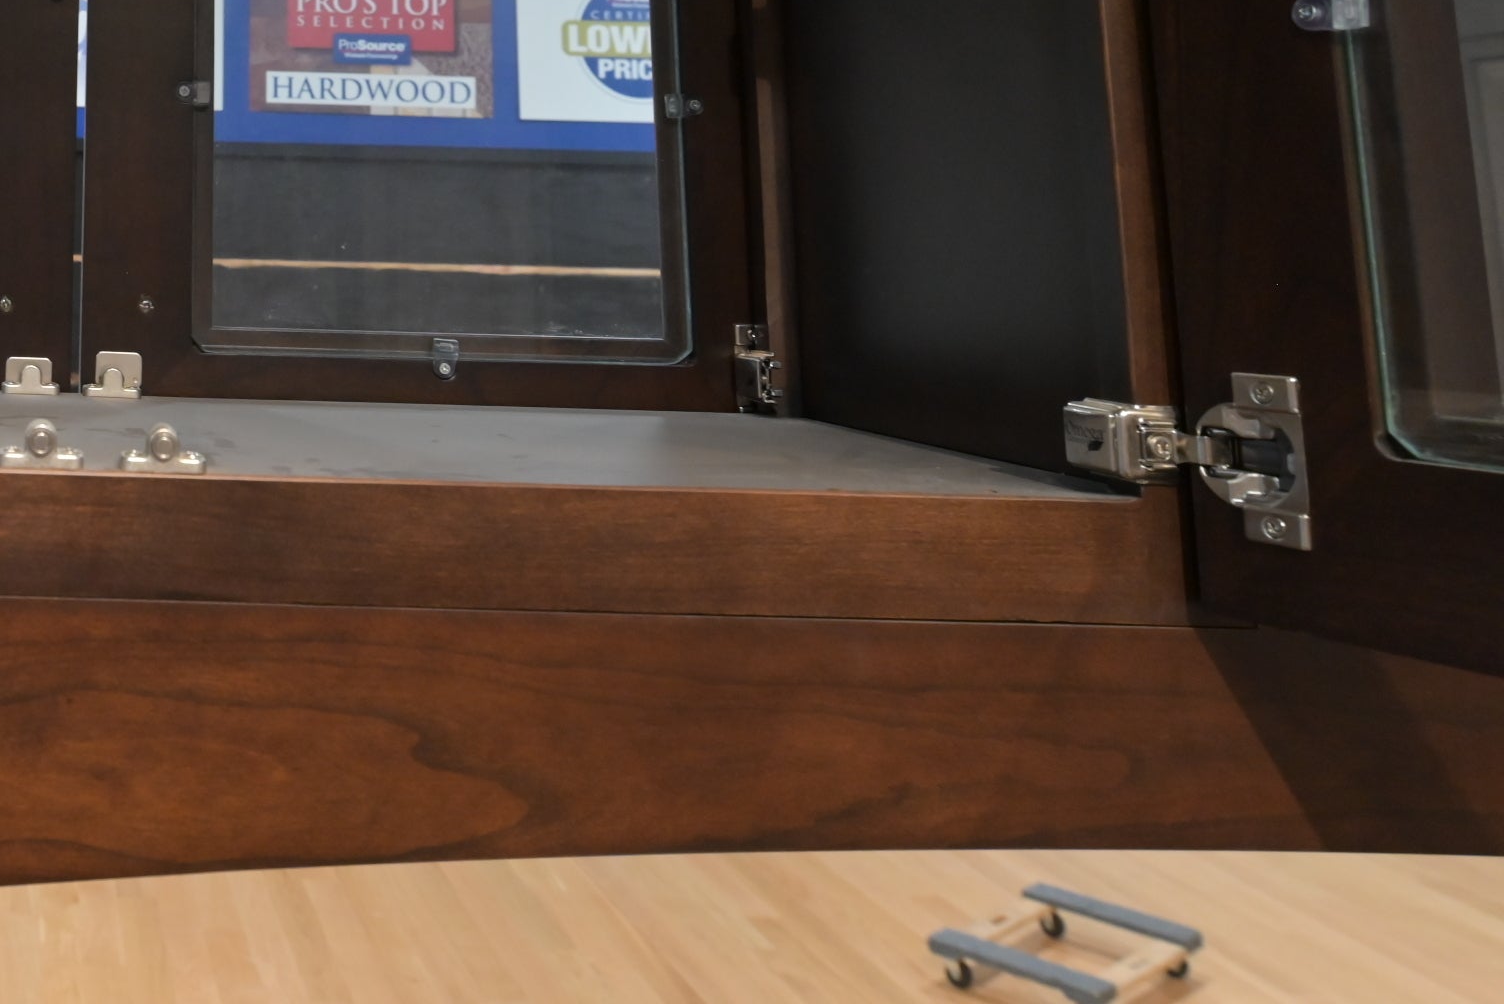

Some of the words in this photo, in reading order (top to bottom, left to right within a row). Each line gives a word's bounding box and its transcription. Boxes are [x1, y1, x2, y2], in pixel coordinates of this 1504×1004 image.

[297, 14, 445, 31] SELECTION
[338, 39, 406, 52] ProSource
[568, 23, 653, 55] LOW
[272, 75, 472, 105] HARDWOOD
